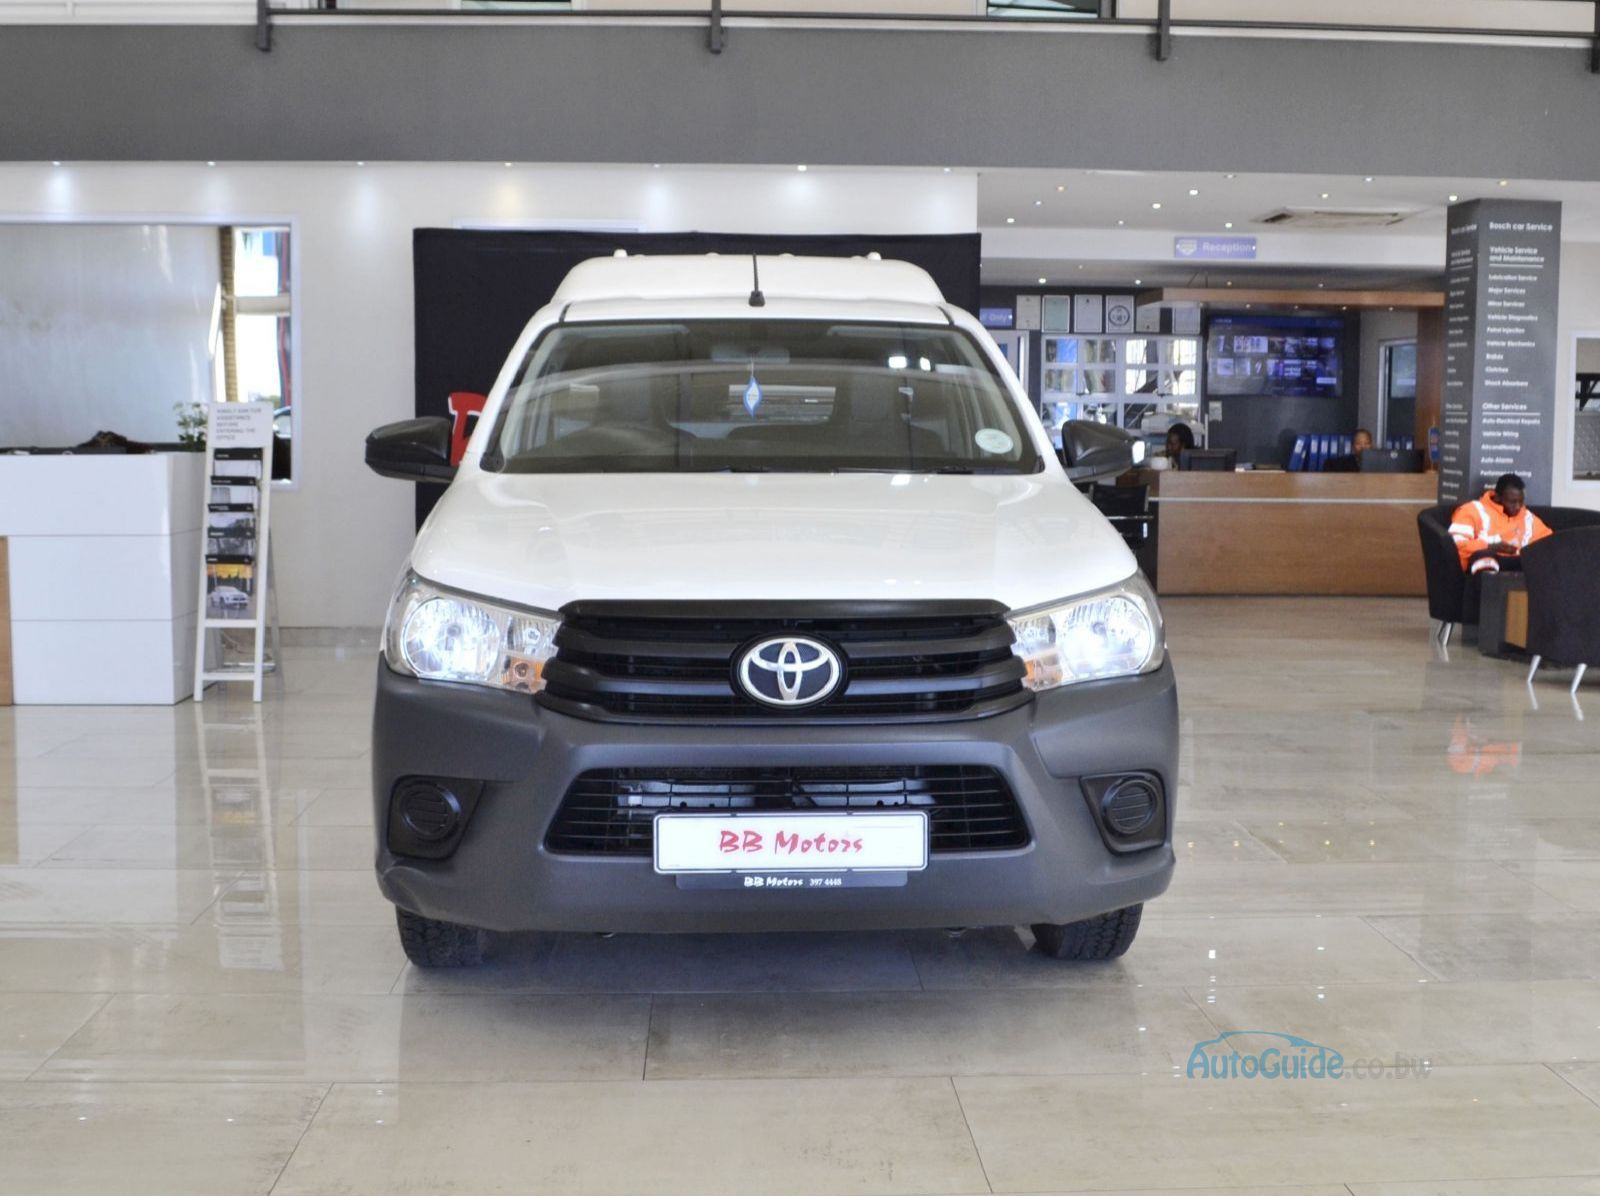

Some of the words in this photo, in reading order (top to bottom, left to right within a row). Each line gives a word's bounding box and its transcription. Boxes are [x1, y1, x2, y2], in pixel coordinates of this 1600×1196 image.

[1489, 222, 1511, 230] Bosch
[1526, 223, 1553, 231] Service
[1203, 242, 1251, 254] Reception
[1489, 246, 1513, 254] Vehicle
[1514, 246, 1538, 254] Service
[1501, 403, 1527, 411] Services
[719, 830, 763, 853] BB
[774, 830, 863, 855] Motors
[744, 876, 764, 887] BB
[766, 876, 803, 887] Motors
